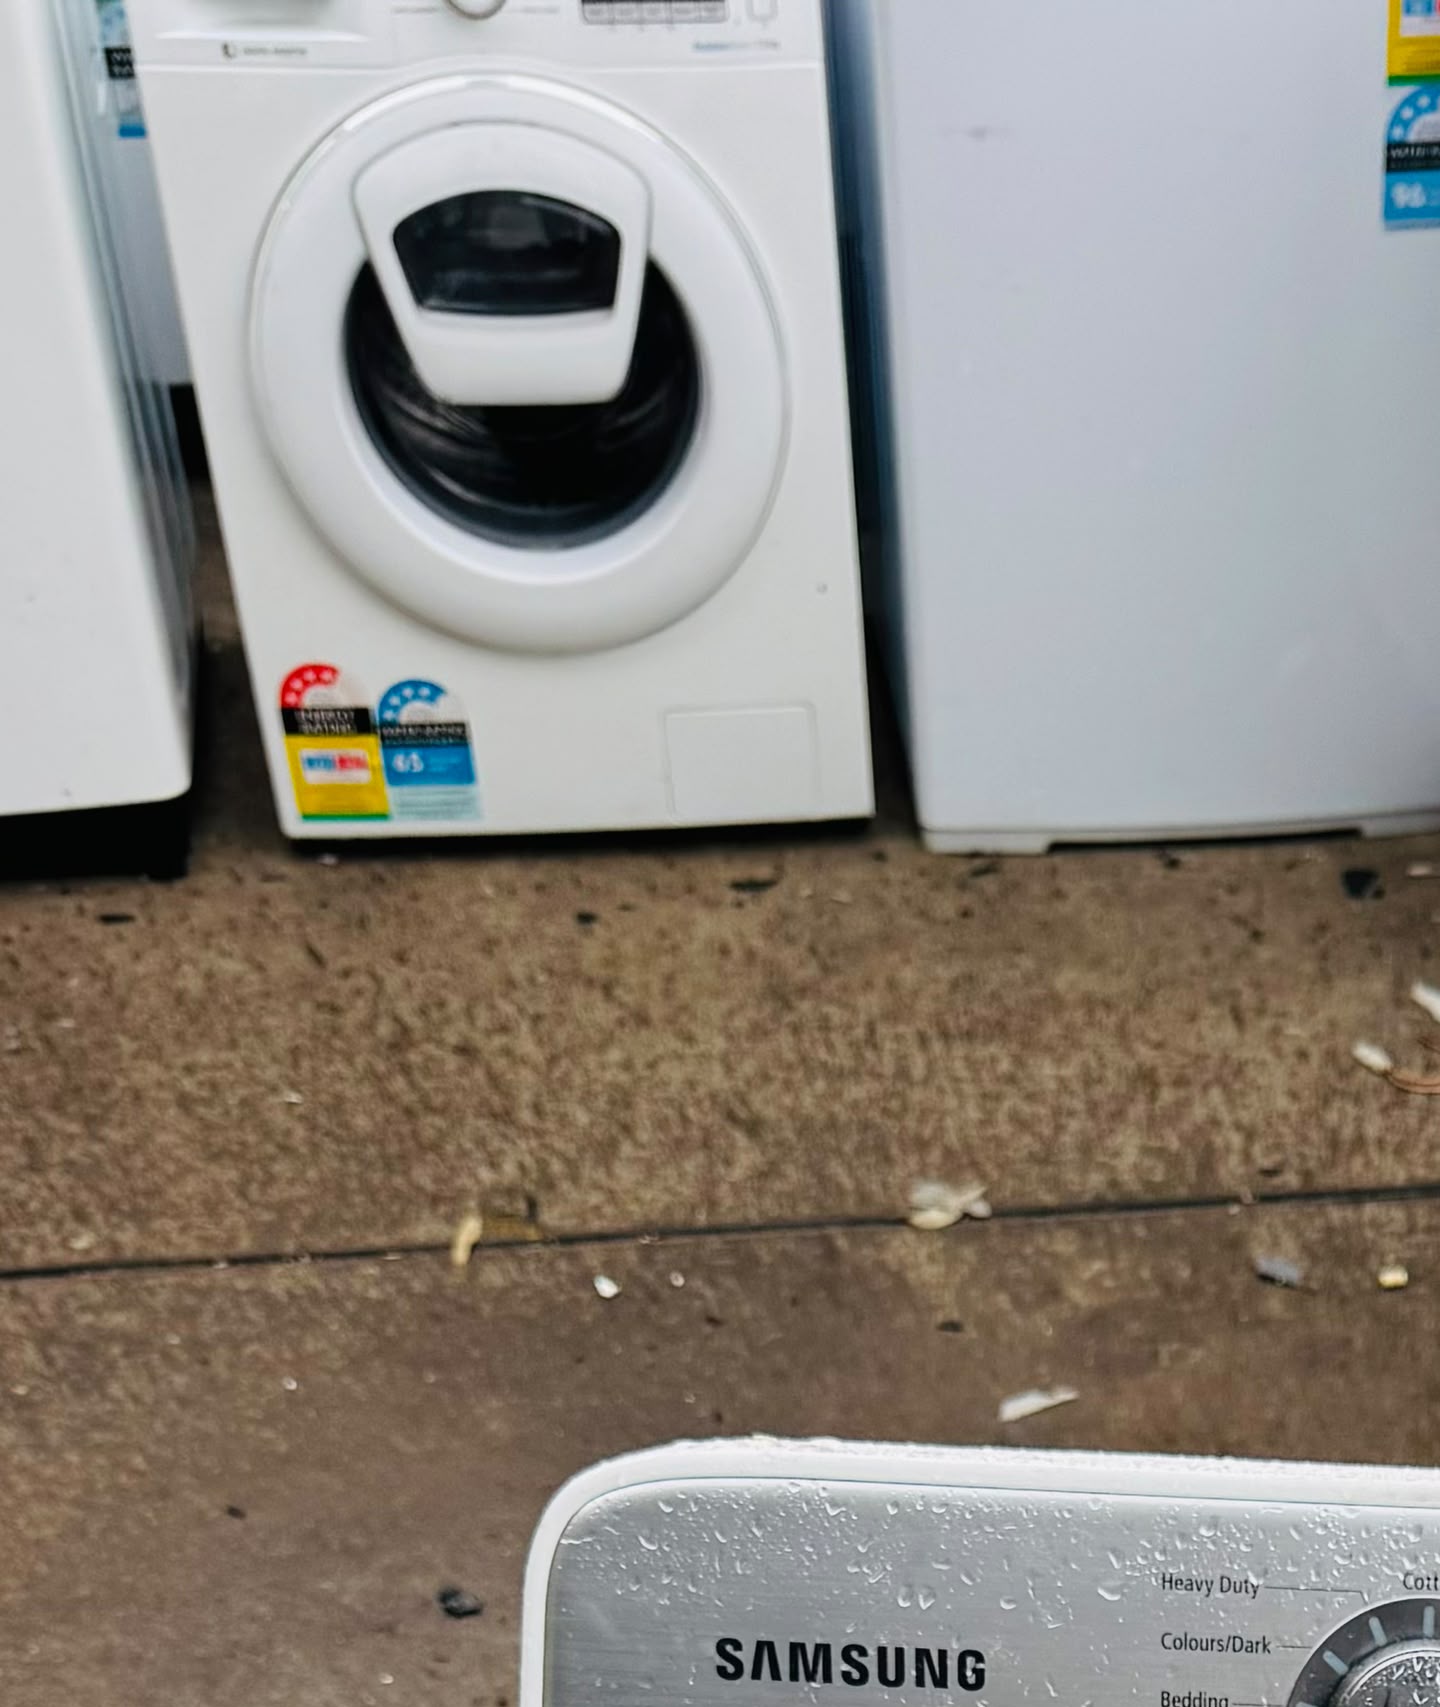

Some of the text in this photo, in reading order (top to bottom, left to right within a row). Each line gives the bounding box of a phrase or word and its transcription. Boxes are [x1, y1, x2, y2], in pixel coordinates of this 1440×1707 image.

[1161, 1573, 1260, 1599] Heavy Duty
[1160, 1632, 1272, 1654] Colours/Dark
[715, 1637, 986, 1691] SAMSUNG
